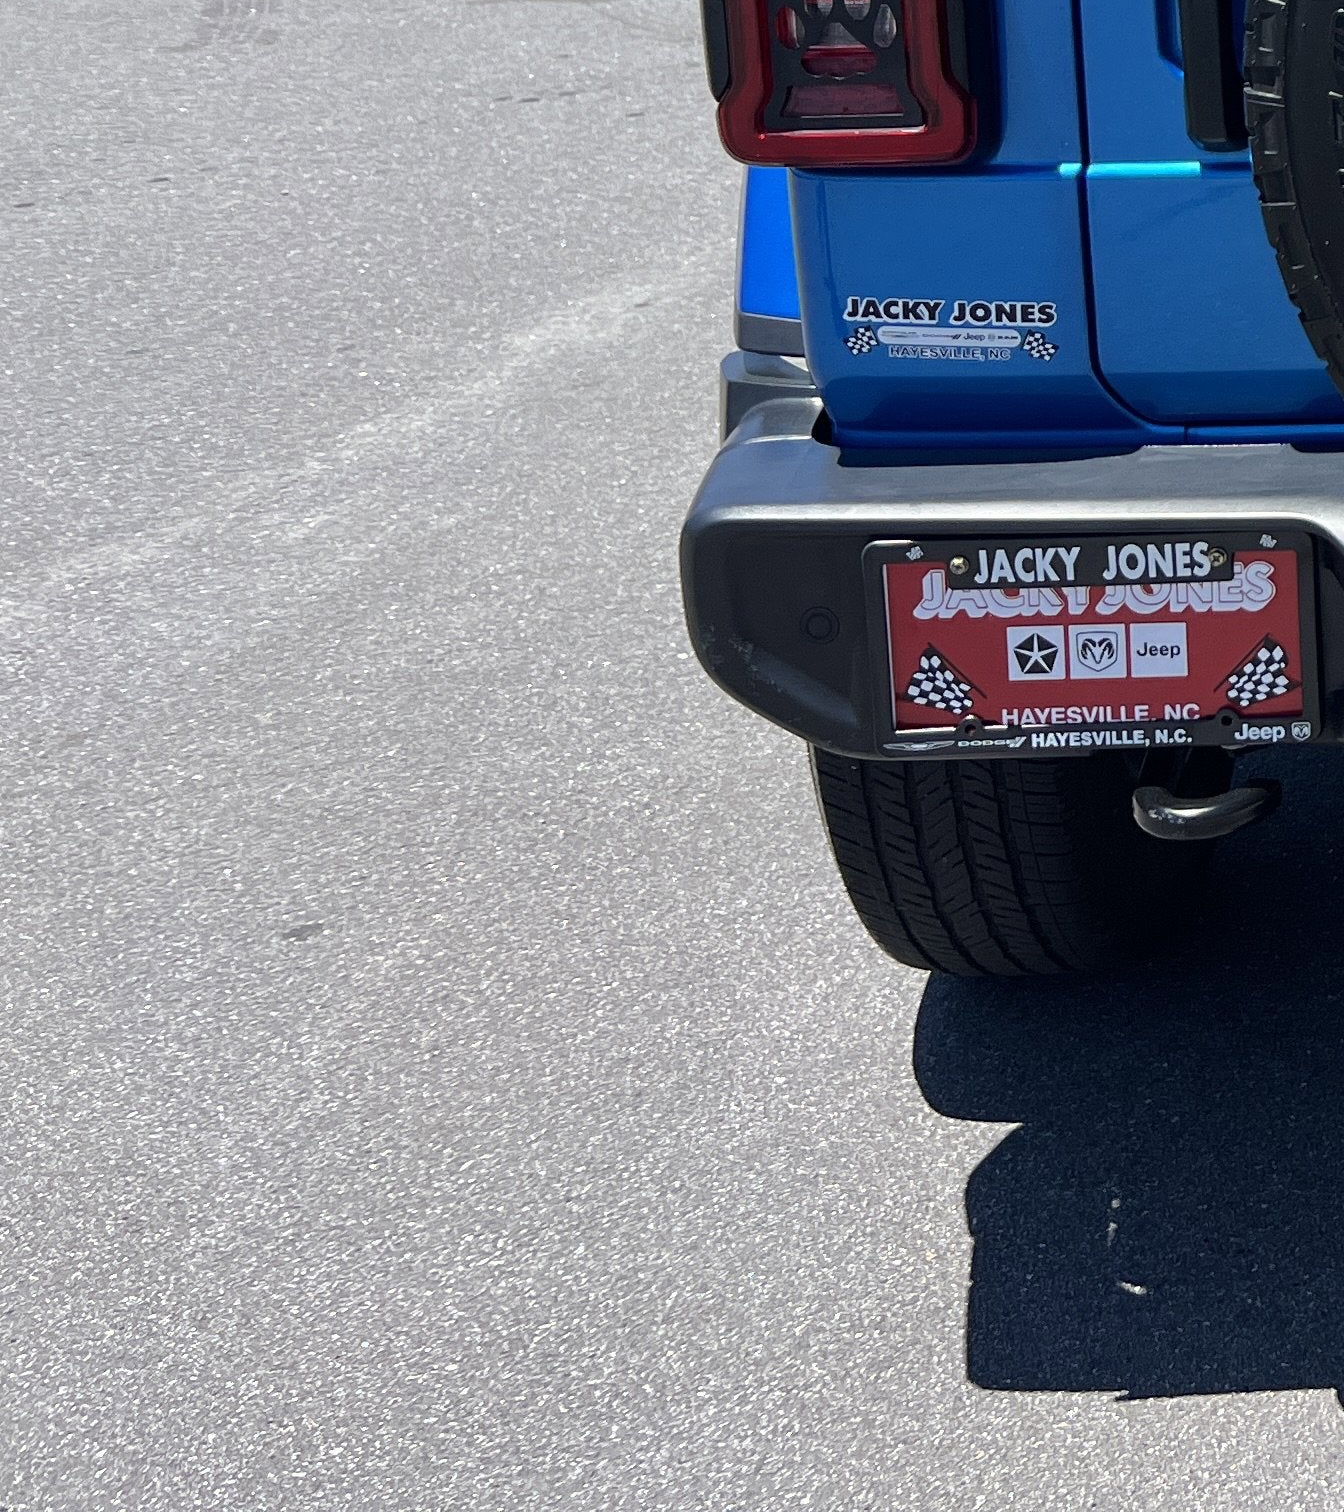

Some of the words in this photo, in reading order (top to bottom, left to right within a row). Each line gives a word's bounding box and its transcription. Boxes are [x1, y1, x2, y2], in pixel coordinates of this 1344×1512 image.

[843, 297, 945, 324] JACKY
[949, 300, 1057, 326] JONES
[988, 348, 1011, 360] NC
[974, 547, 1081, 584] JACKY
[1102, 541, 1212, 581] JONES
[1136, 642, 1181, 658] Jeep
[1164, 703, 1200, 721] NC
[1031, 730, 1150, 748] HAYESVILLE,
[1155, 729, 1193, 745] N.C.
[1234, 723, 1285, 742] Jeep
